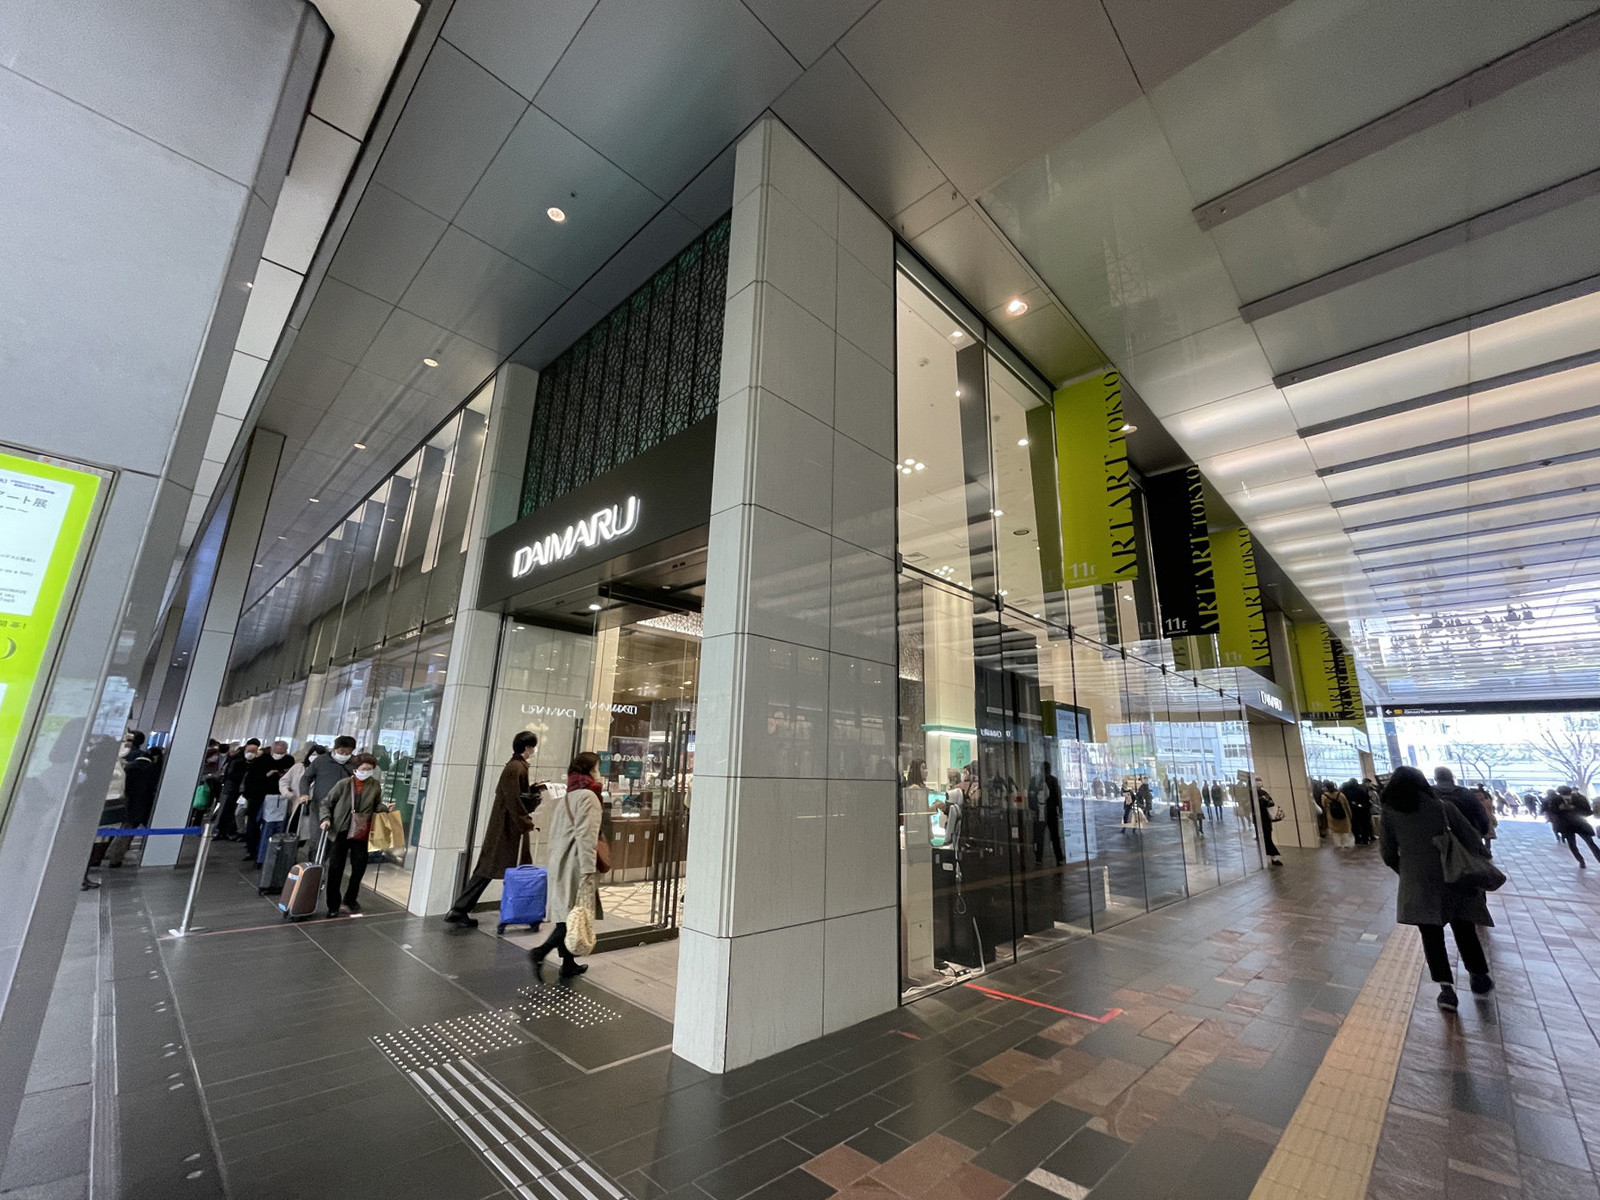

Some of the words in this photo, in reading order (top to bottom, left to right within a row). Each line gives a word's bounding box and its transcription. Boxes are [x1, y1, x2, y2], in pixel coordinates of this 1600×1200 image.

[1103, 371, 1125, 448] TOKYO
[1186, 467, 1207, 530] TOKYO
[512, 496, 640, 578] DAIMARU
[1238, 527, 1257, 579] TOKYO
[1165, 617, 1188, 630] 11F
